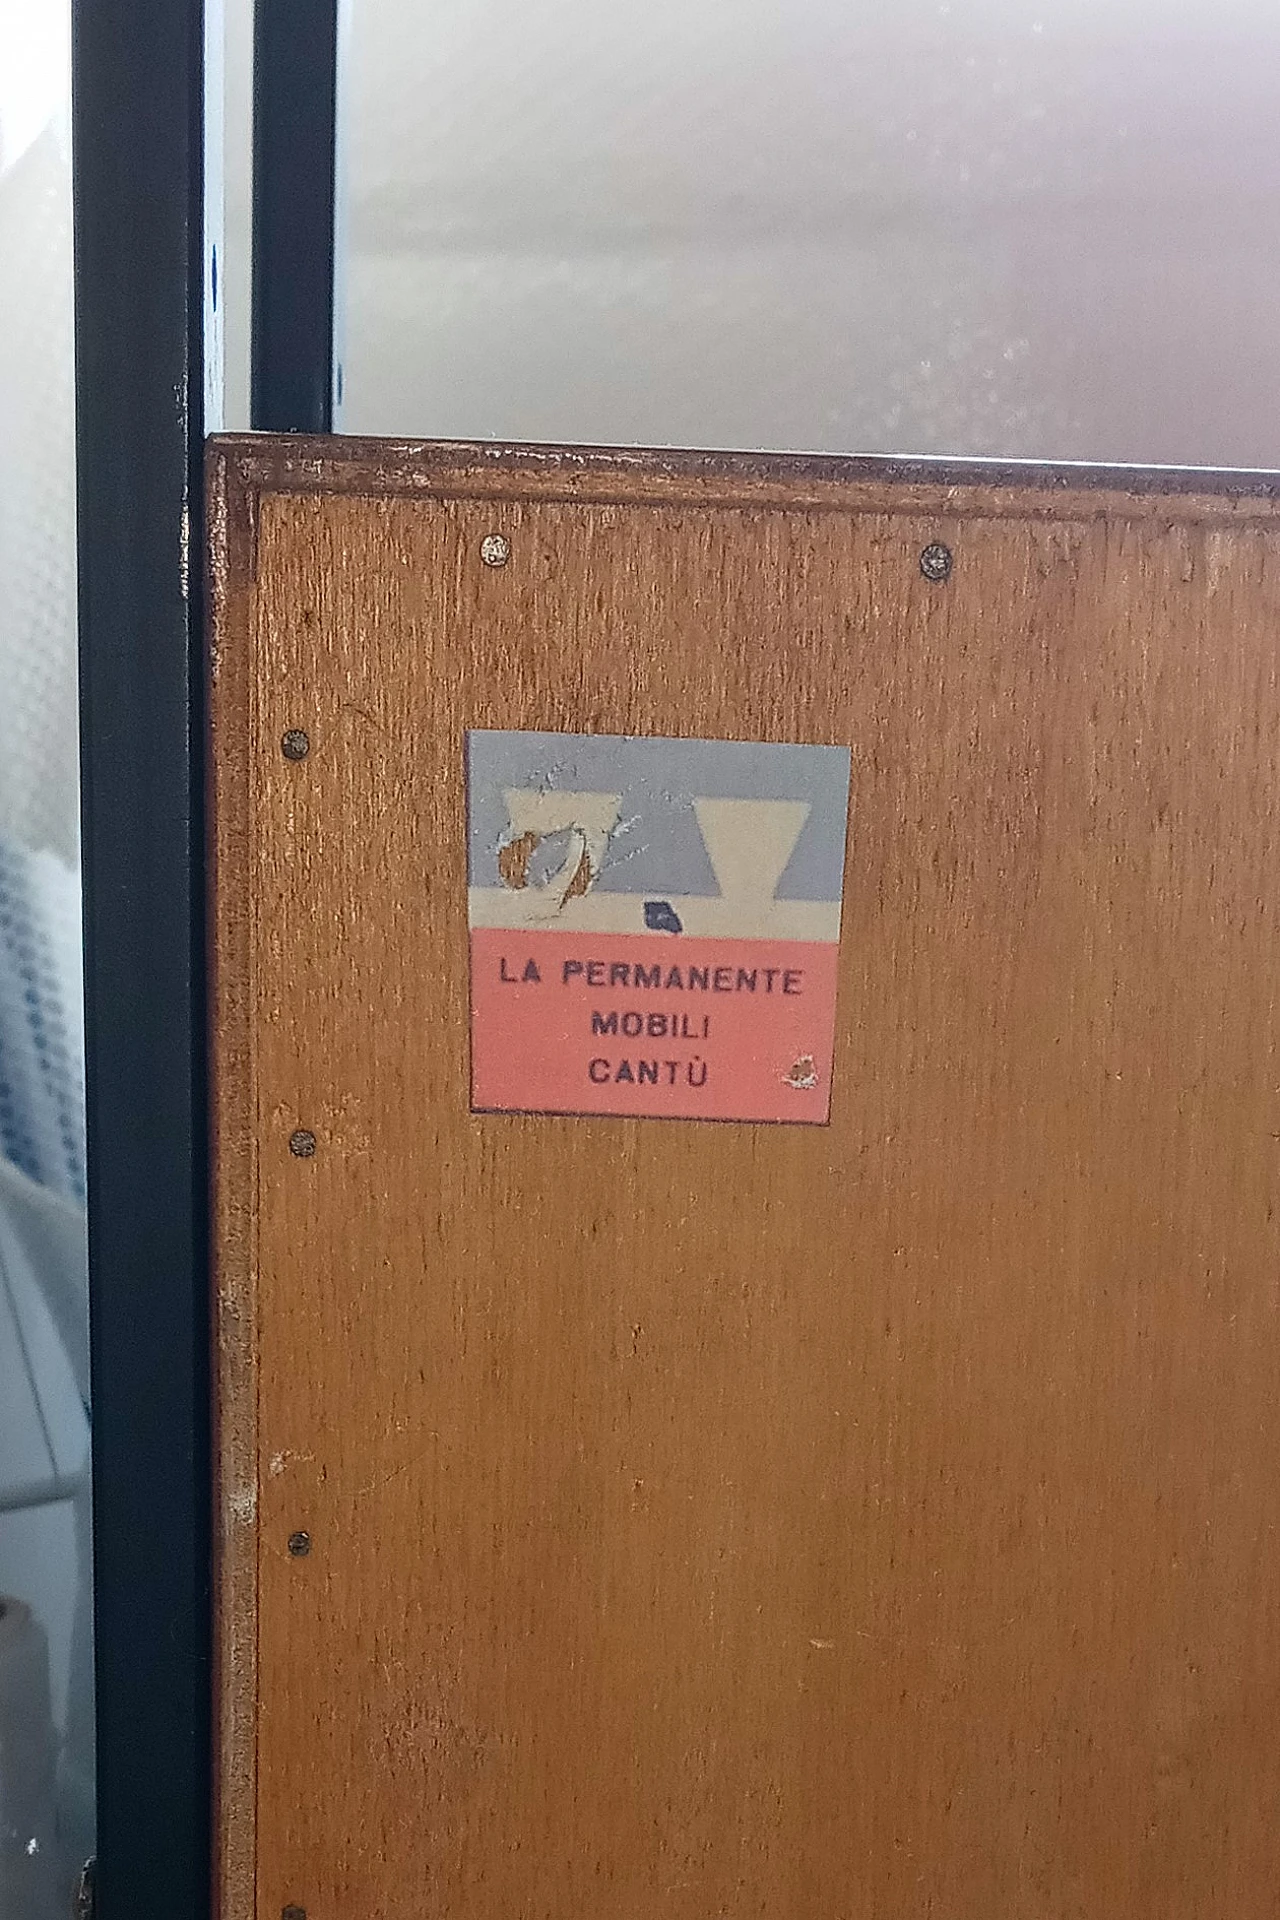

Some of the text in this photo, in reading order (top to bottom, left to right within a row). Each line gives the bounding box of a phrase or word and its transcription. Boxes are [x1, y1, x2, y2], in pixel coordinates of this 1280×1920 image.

[499, 957, 804, 995] LA PERMANENTE
[591, 1010, 709, 1039] MOBILI
[588, 1055, 708, 1087] CANTÙ
